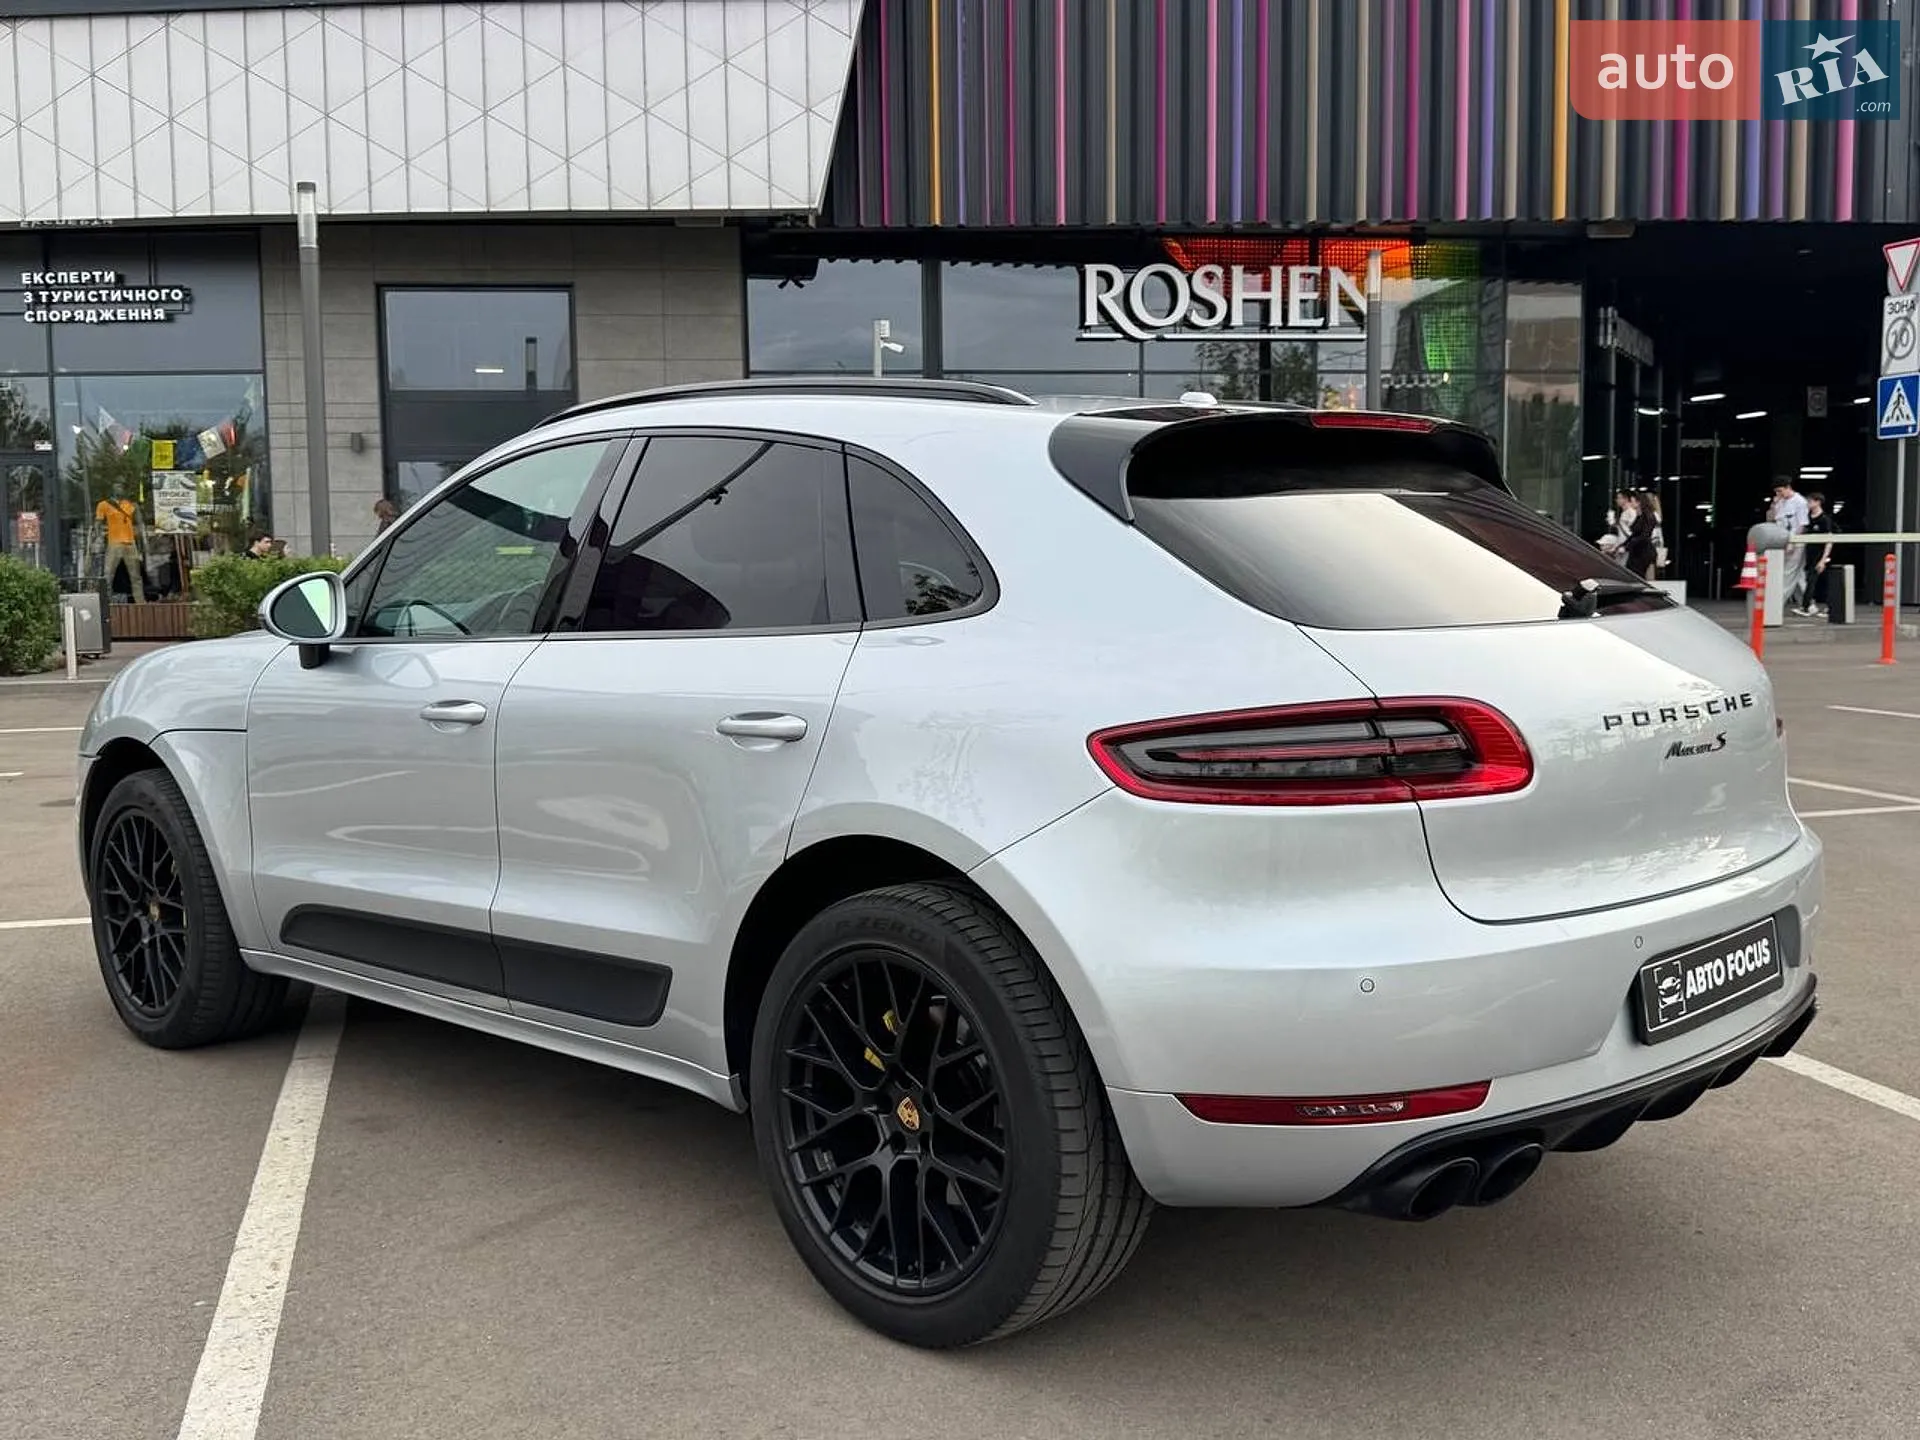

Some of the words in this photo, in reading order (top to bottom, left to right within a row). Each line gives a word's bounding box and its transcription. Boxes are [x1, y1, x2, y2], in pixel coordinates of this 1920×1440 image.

[21, 271, 115, 285] ЕКСПЕРТИ
[39, 289, 183, 302] ТУРИСТИЧНОГО
[1084, 262, 1367, 340] ROSHEN
[24, 308, 165, 322] СПОРЯДЖЕННЯ
[1887, 300, 1916, 315] ЗОНА
[1603, 693, 1753, 731] PORSCHE
[1712, 732, 1727, 751] S
[1726, 938, 1771, 981] FOCUS
